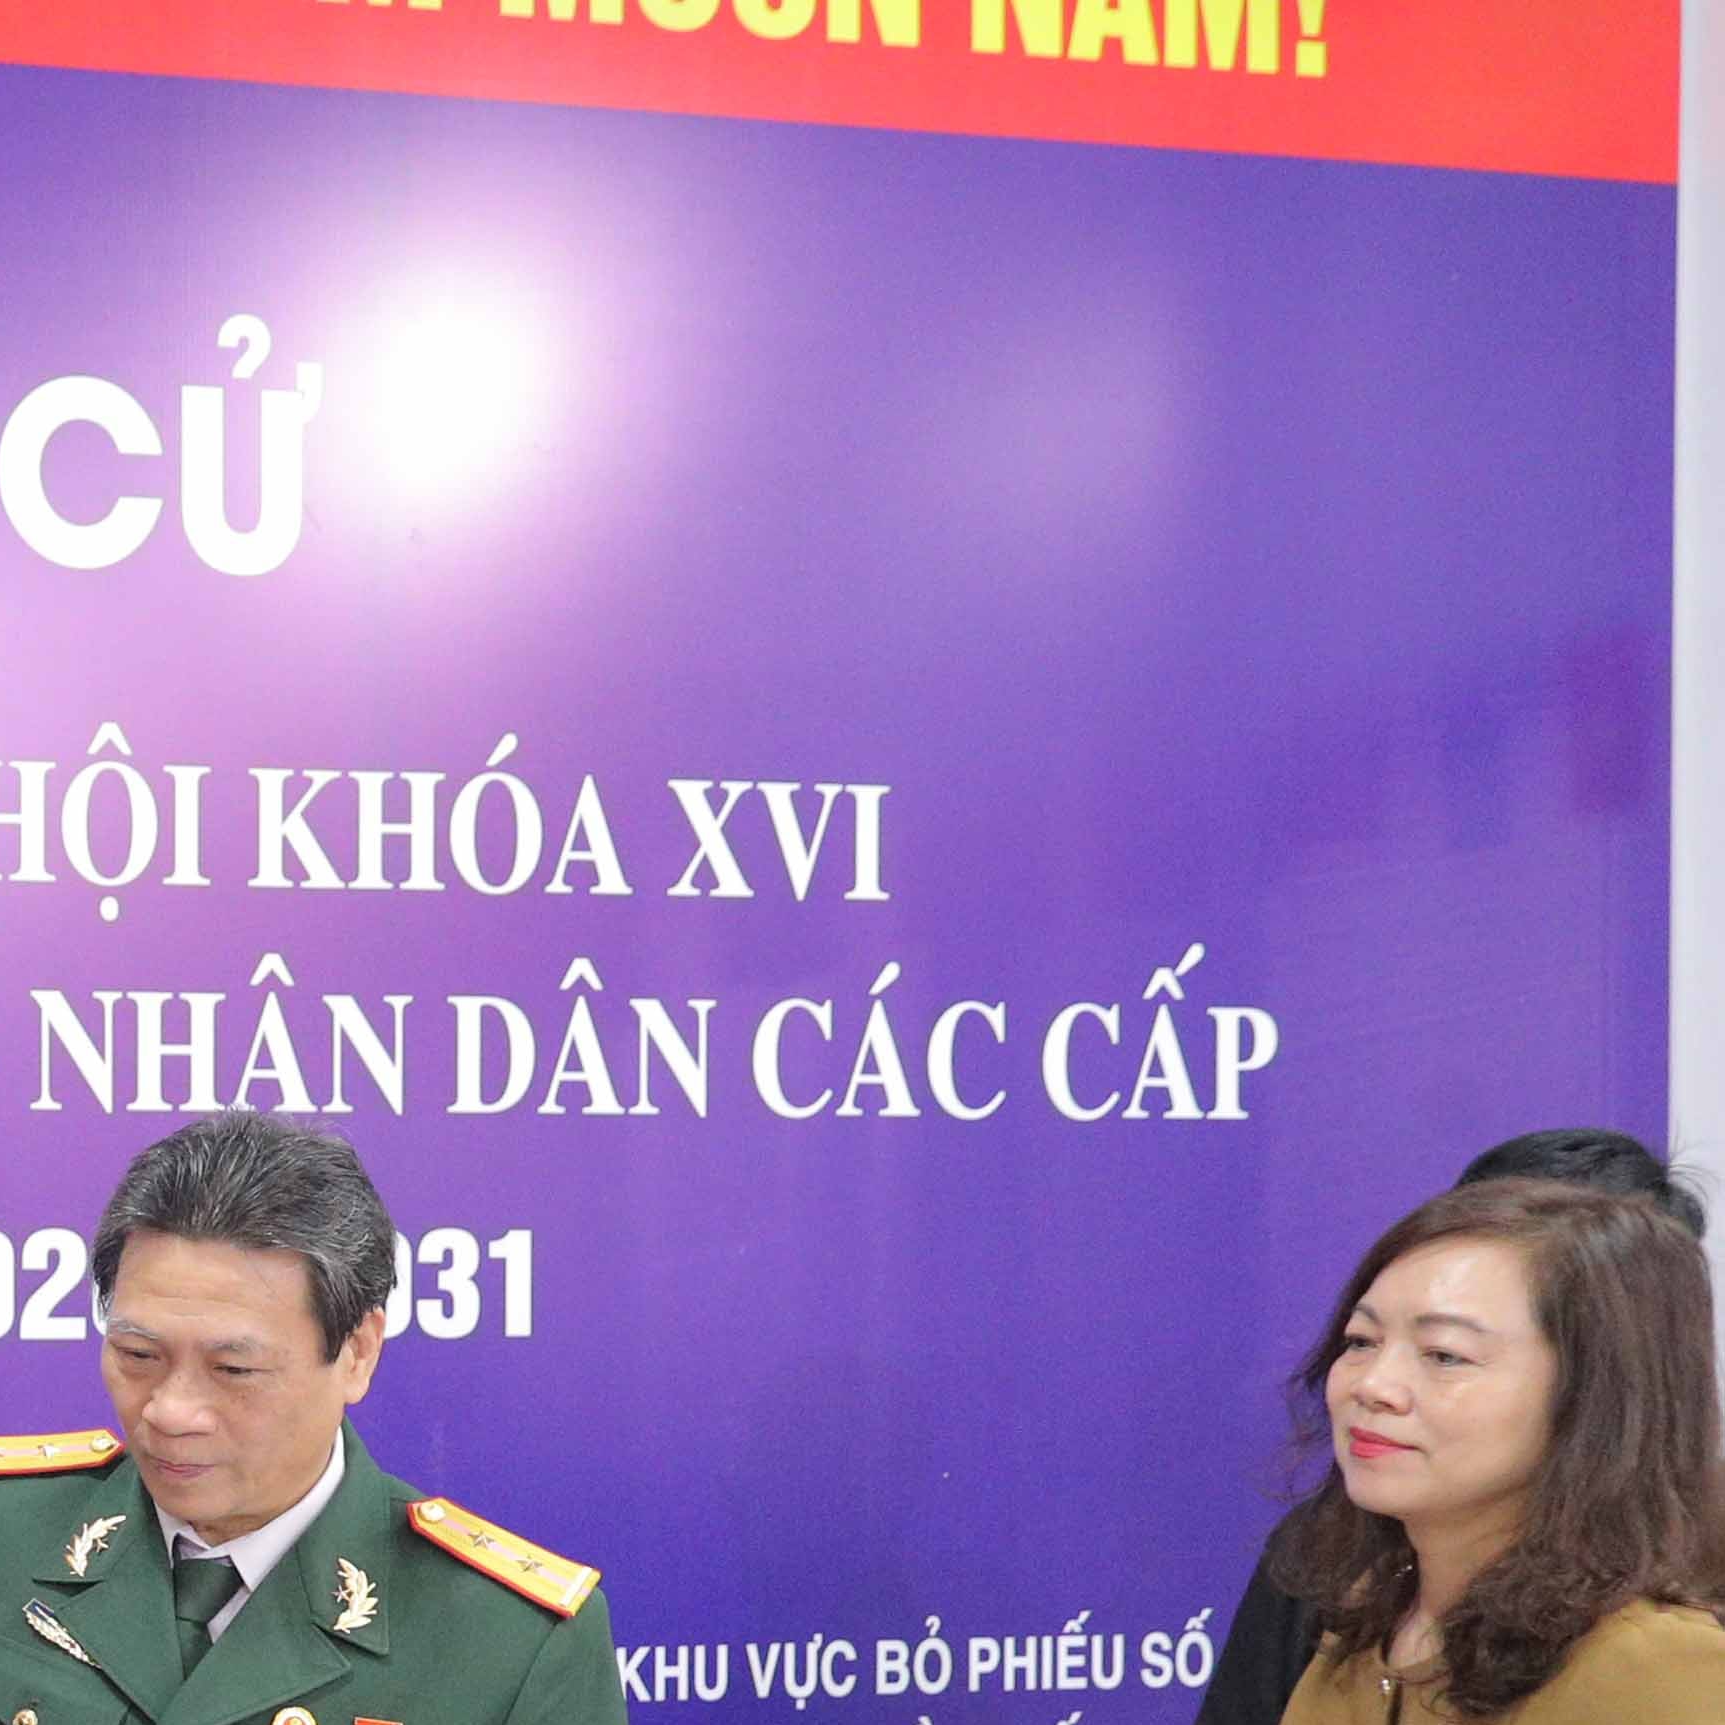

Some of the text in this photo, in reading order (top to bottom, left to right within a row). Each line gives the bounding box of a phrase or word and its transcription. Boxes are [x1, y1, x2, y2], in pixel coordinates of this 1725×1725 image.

[248, 733, 632, 896] KHÓA
[667, 779, 891, 901] XVI
[30, 953, 414, 1115] NHÂN
[447, 958, 717, 1118] DÂN
[752, 962, 1006, 1120] CÁC
[1042, 943, 1279, 1121] CẤP
[616, 1608, 1214, 1710] KHU VỰC BỎ PHIẾU SỐ
